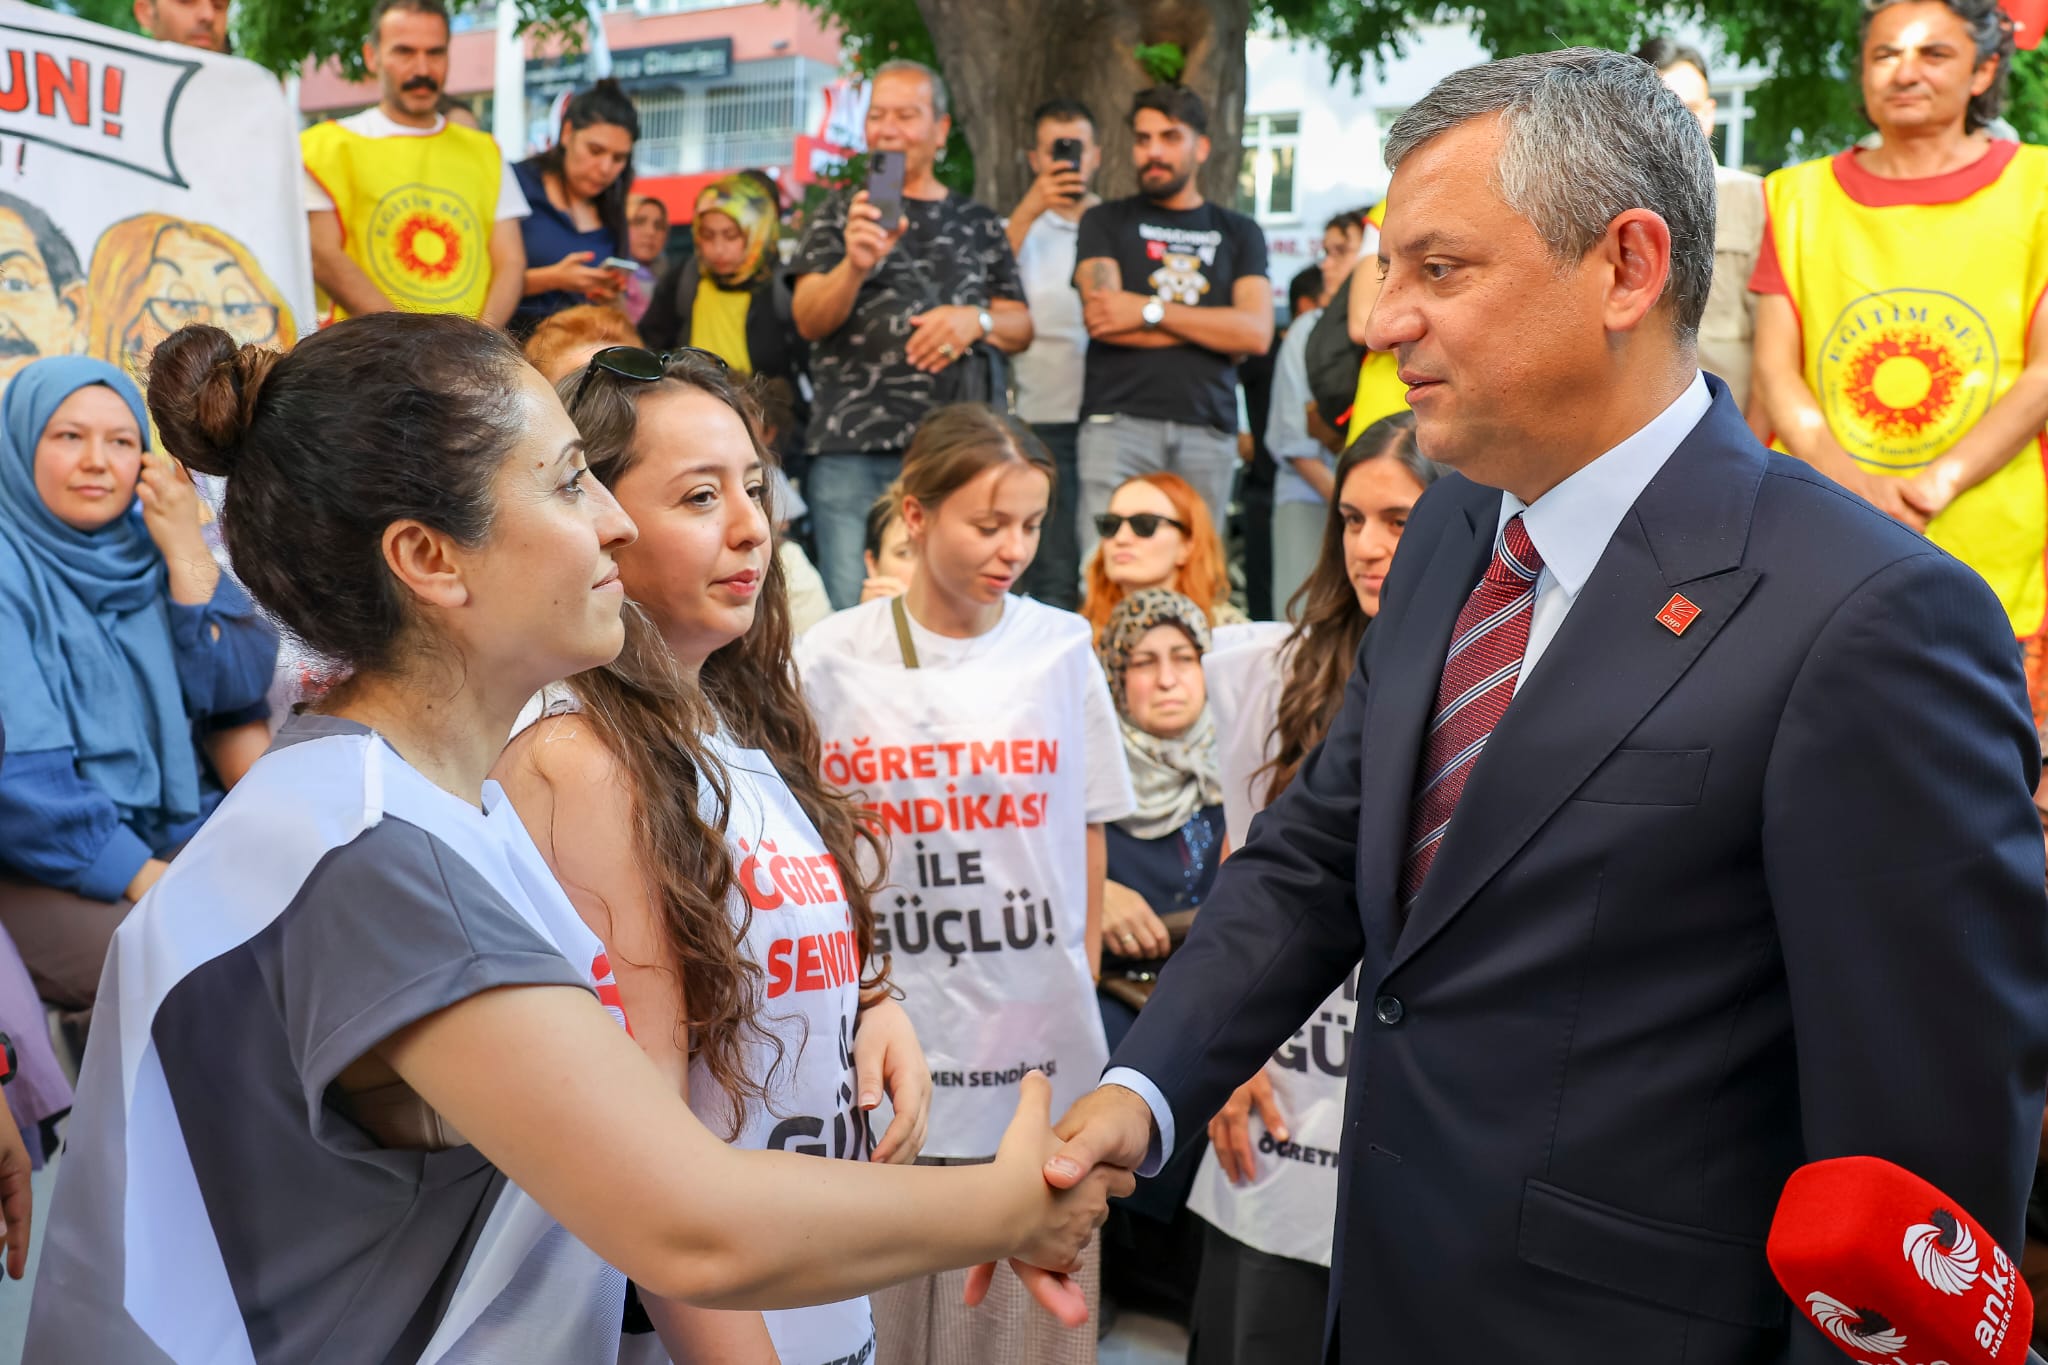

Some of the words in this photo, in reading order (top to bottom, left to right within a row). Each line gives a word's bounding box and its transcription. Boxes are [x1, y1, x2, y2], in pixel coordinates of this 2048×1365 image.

[1662, 614, 1681, 628] CHP
[824, 736, 1058, 786] ÖĞRETMEN
[915, 840, 985, 888] İLE
[1975, 1245, 2009, 1349] anka
[1989, 1311, 2012, 1359] HABER
